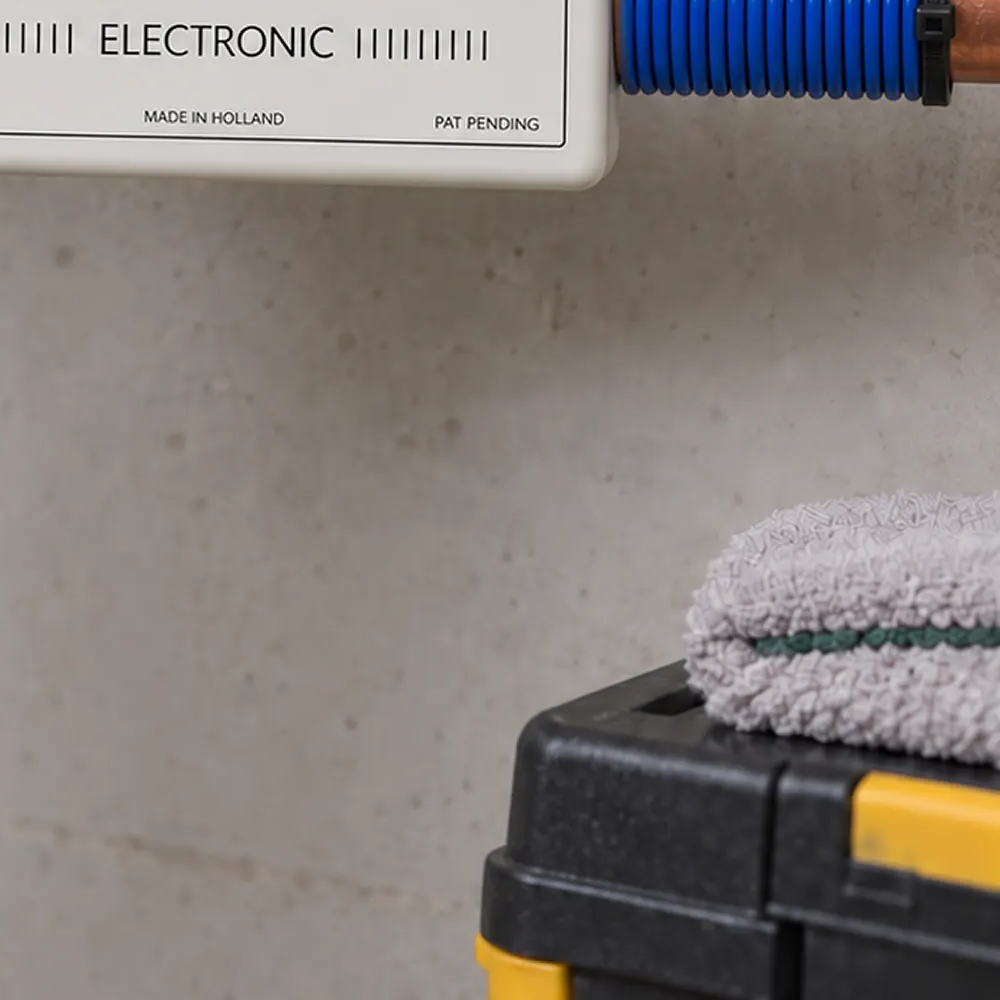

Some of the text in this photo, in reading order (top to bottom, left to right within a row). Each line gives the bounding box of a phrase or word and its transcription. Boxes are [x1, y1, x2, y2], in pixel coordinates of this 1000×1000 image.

[100, 23, 335, 59] ELECTRONIC
[143, 109, 285, 127] MADE IN HOLLAND
[434, 115, 540, 132] PAT PENDING
